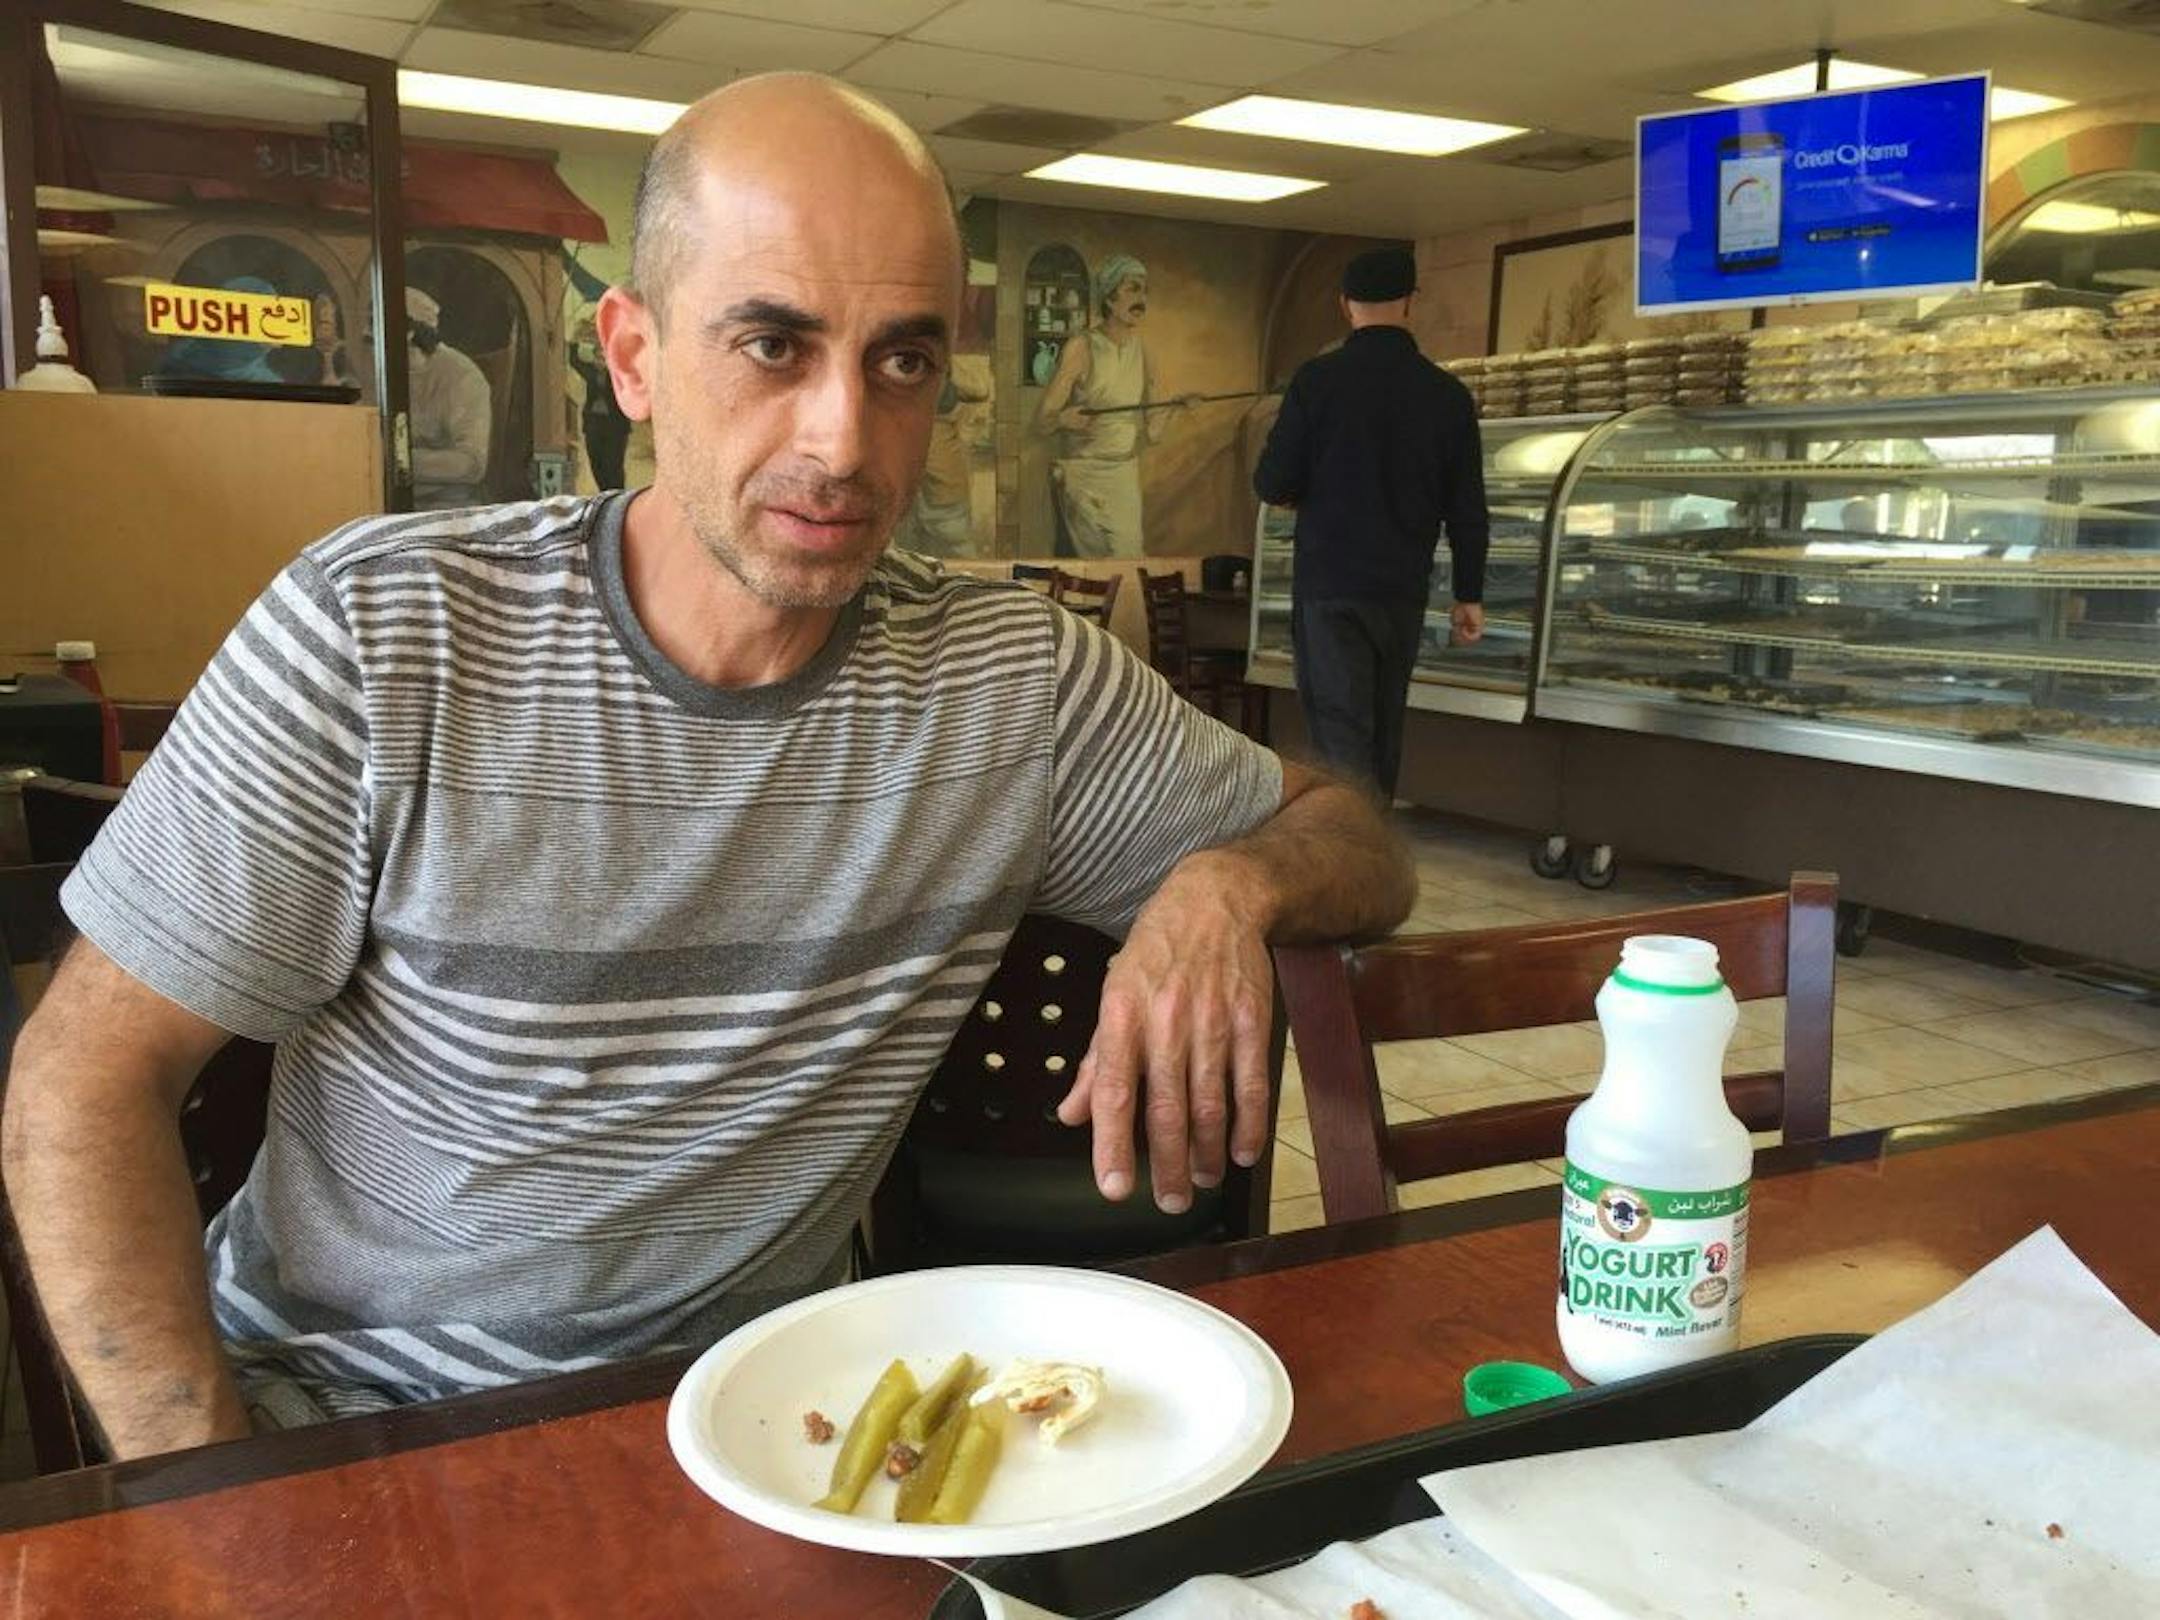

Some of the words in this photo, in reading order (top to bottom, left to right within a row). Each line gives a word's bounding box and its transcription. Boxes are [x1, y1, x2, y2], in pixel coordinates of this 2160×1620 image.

[151, 295, 249, 335] PUSH
[1567, 1227, 1697, 1278] YOGURT
[1573, 1275, 1686, 1319] DRINK
[1655, 1325, 1686, 1338] Mint
